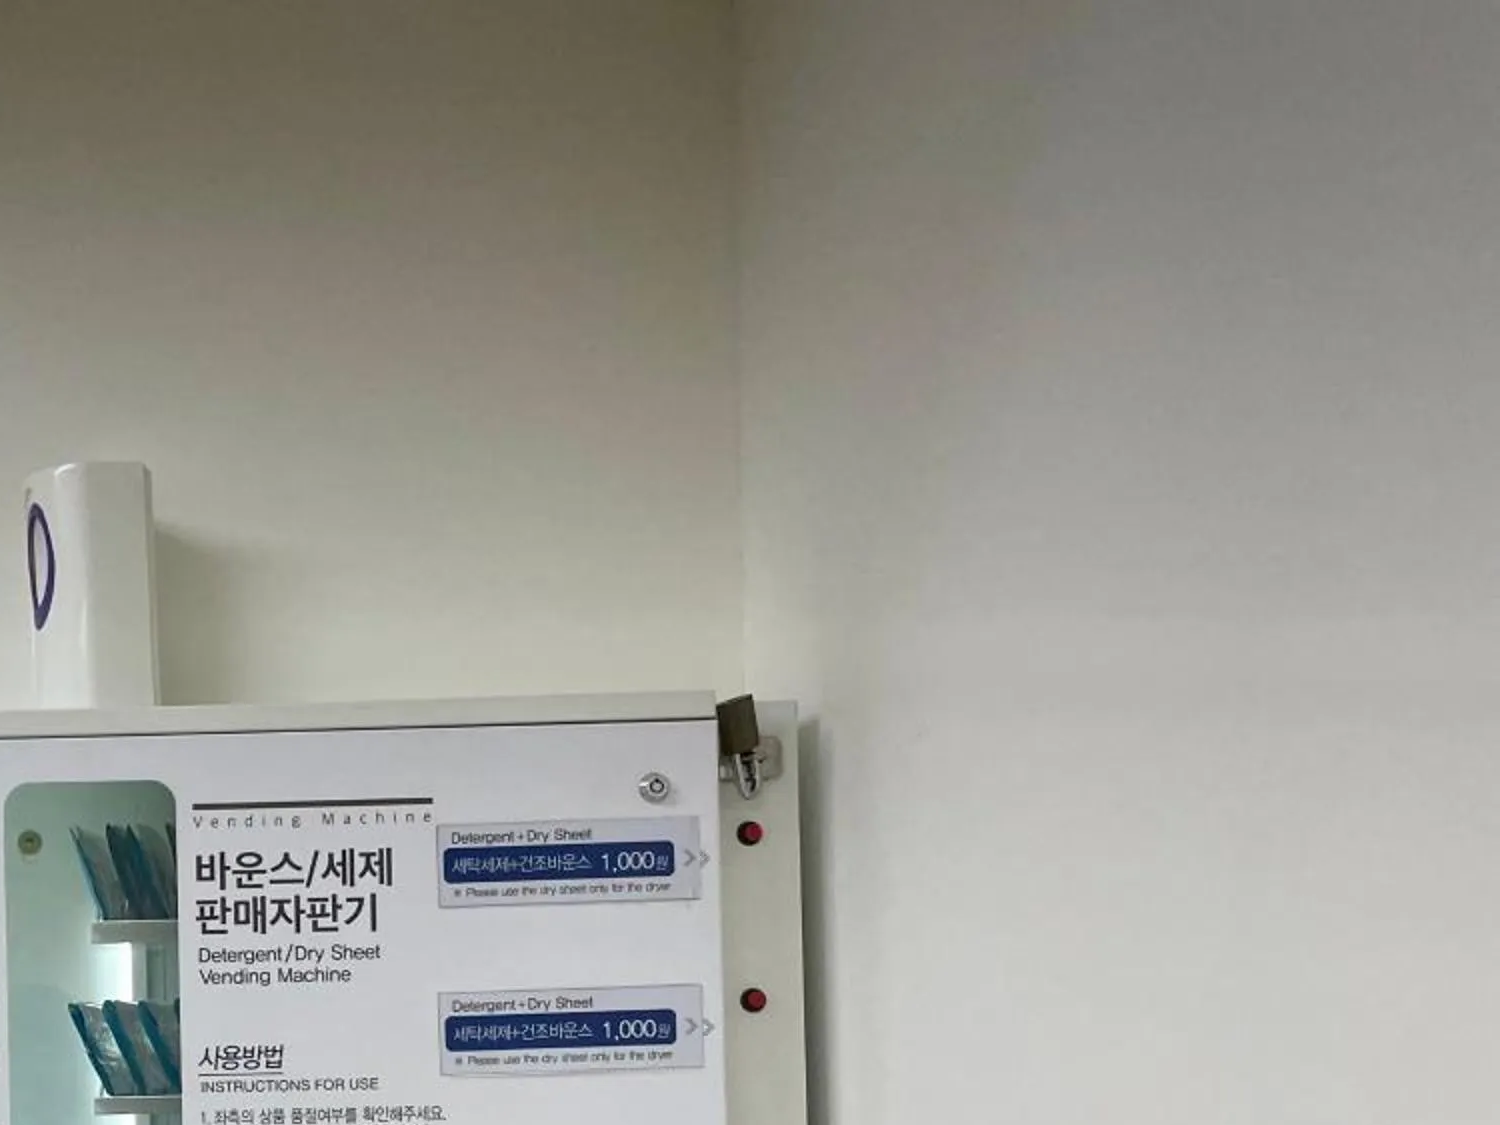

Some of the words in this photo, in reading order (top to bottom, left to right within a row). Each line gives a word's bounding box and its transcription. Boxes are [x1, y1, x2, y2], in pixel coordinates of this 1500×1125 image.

[193, 813, 301, 829] Vending
[321, 811, 433, 826] Machine
[555, 829, 592, 840] Sheet
[195, 847, 393, 889] 바운스/세제
[602, 851, 668, 873] 1,000원
[194, 893, 379, 936] 판매자판기
[198, 945, 324, 968] Detergent/Dry
[331, 944, 380, 962] Sheet
[199, 967, 271, 986] Vending
[277, 966, 351, 983] Machine
[556, 996, 593, 1009] Sheet
[604, 1019, 671, 1041] 1,000원
[199, 1044, 284, 1071] 사용방법
[201, 1079, 310, 1093] INSTRUCTIONS
[314, 1078, 345, 1091] FOR
[349, 1077, 379, 1090] USE
[215, 1107, 254, 1125] 좌측의
[260, 1108, 284, 1125] 상품
[292, 1107, 356, 1124] 품절여부를
